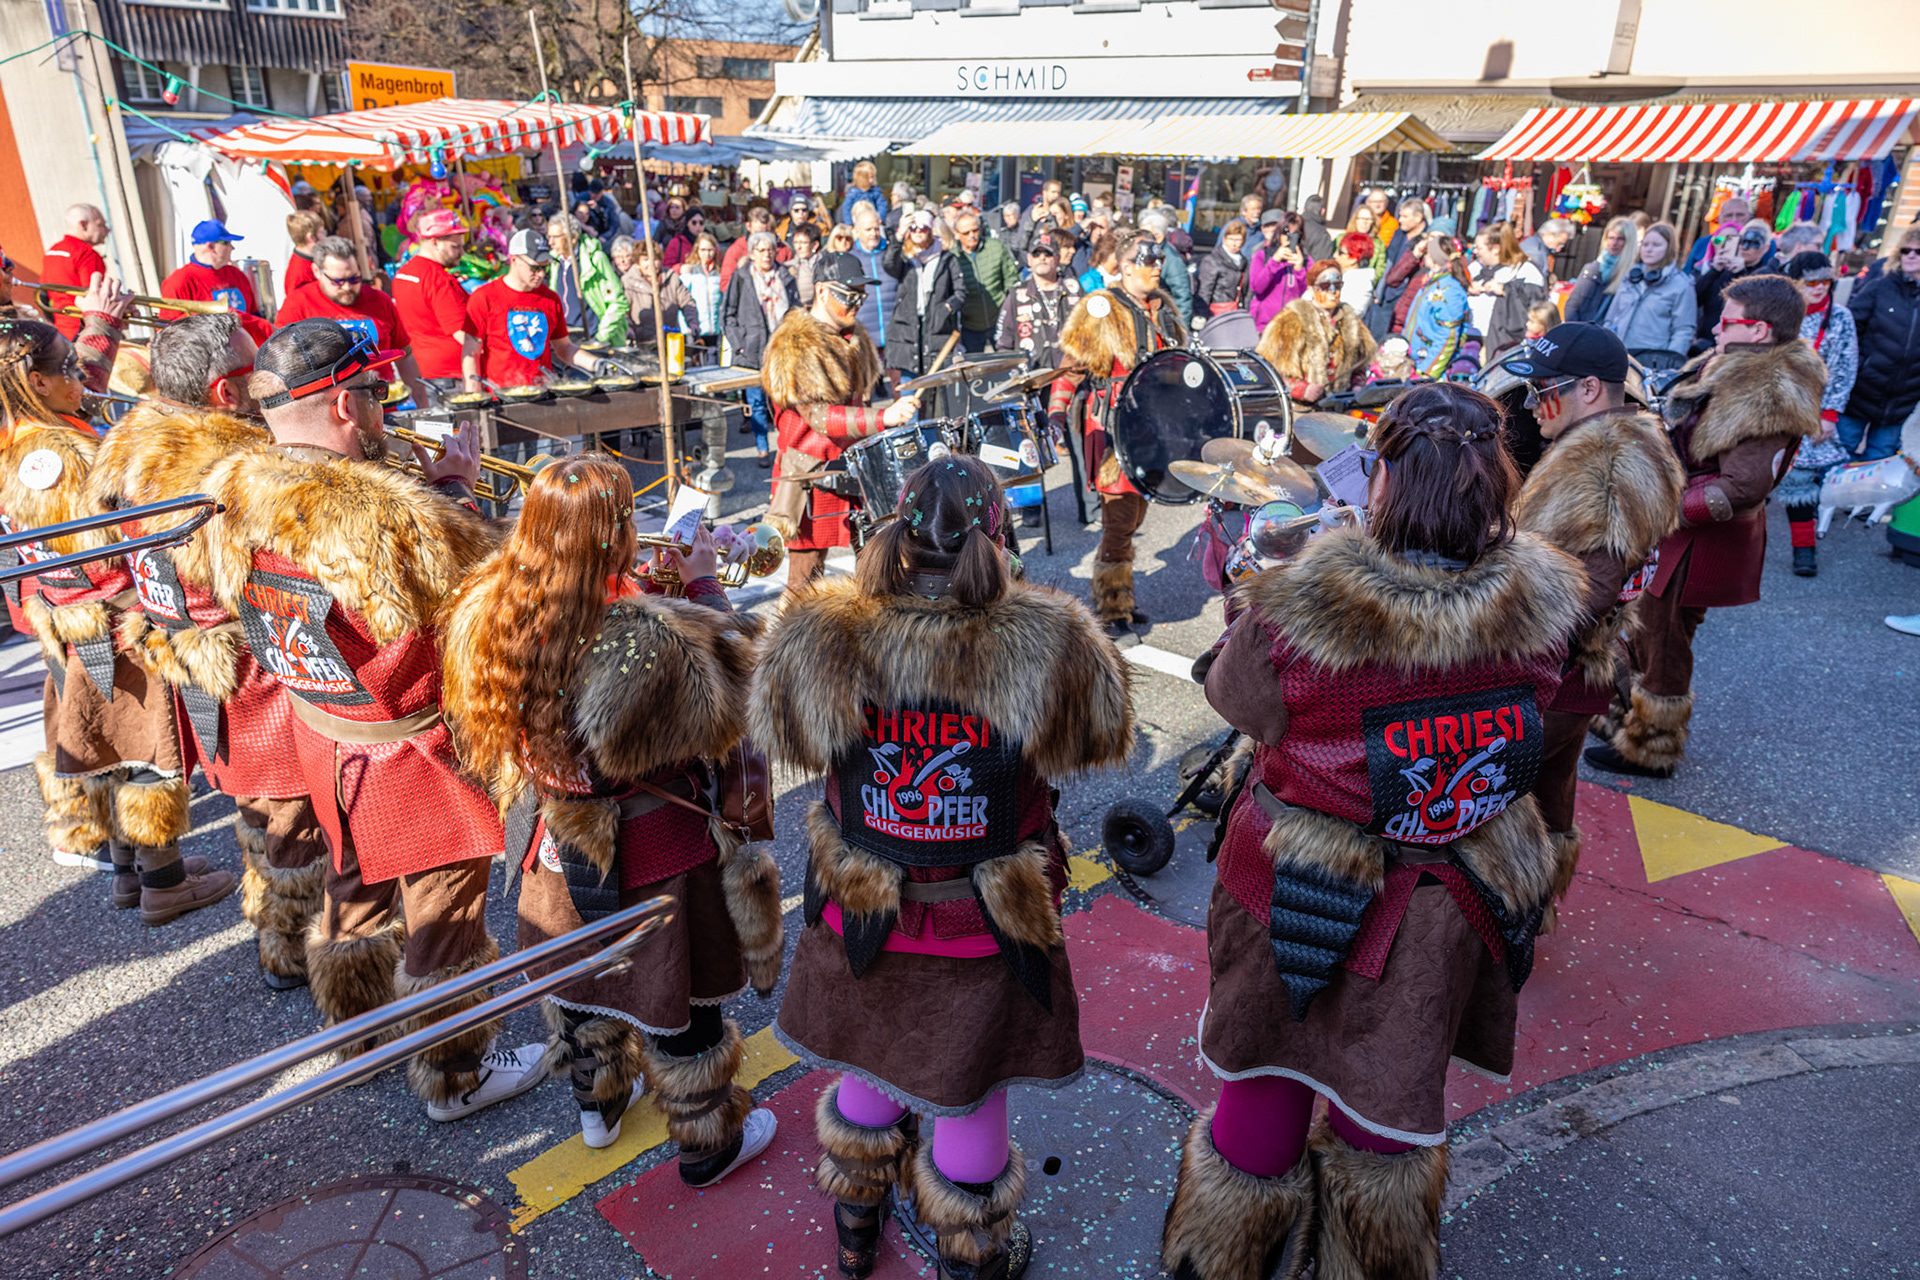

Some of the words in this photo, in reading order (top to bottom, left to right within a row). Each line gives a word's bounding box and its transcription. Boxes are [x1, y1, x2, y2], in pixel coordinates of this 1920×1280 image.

[360, 72, 446, 96] Magenbrot
[957, 65, 1067, 91] SCHMID
[244, 583, 310, 625] CHRIESI
[1384, 704, 1525, 762] CHRIESI
[896, 789, 924, 806] 1996
[1428, 800, 1455, 820] 1996
[865, 814, 985, 840] GUGGEMUSIG
